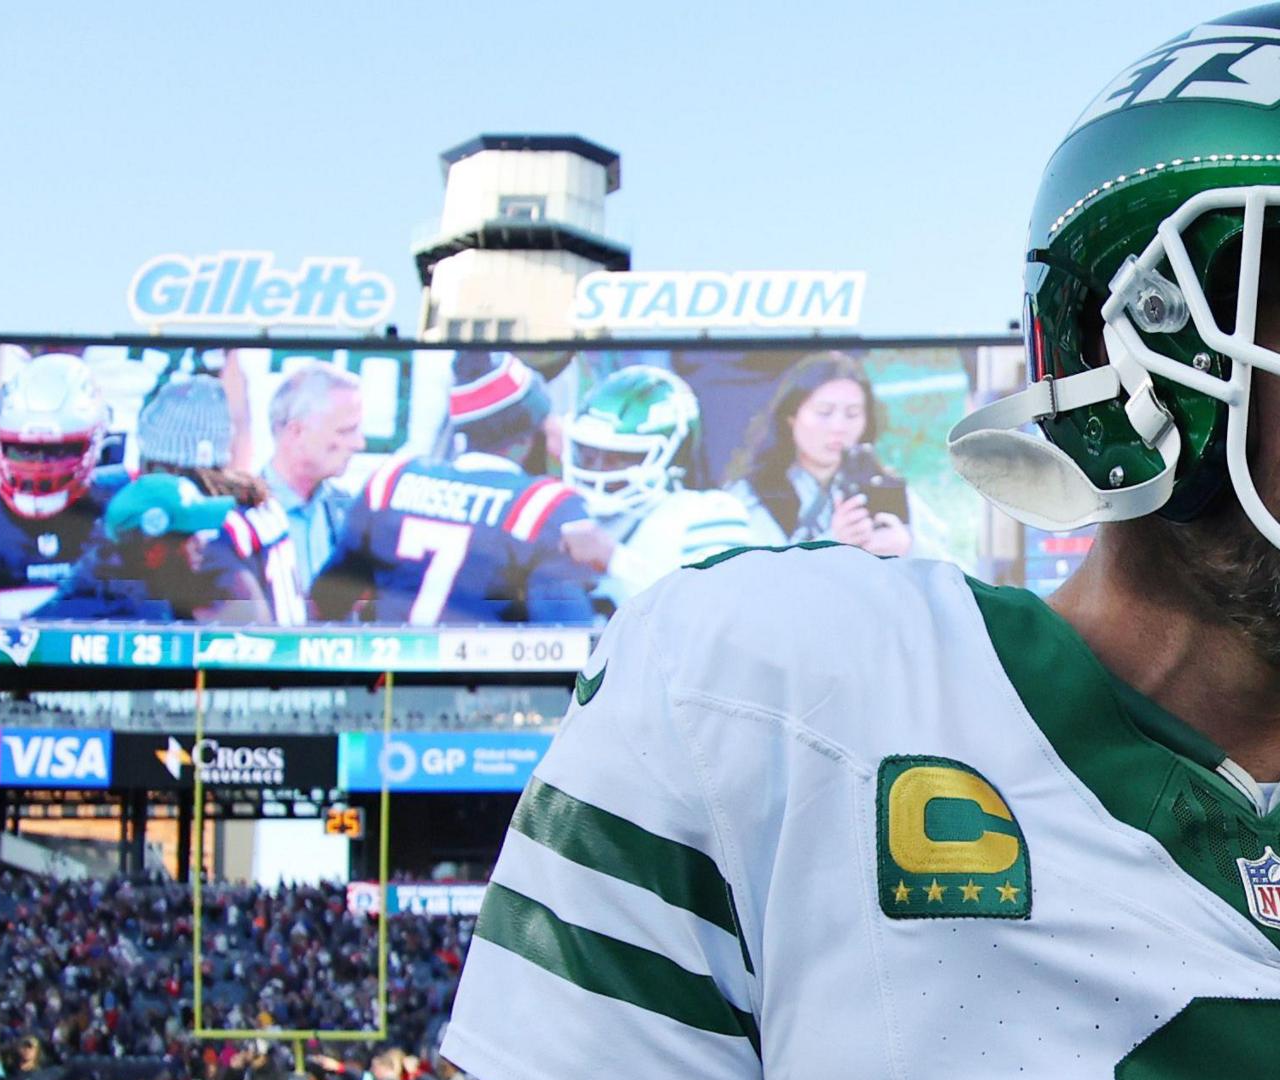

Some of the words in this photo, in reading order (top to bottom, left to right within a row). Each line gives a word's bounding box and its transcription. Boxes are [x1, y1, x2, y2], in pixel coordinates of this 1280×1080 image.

[132, 257, 389, 320] Gillette
[575, 279, 856, 320] STADIUM
[397, 515, 472, 625] 7
[71, 634, 109, 664] NE
[132, 634, 162, 665] 25
[455, 641, 467, 660] 4
[512, 641, 563, 661] 0:00
[3, 736, 107, 779] VISA
[192, 738, 284, 770] CROSS
[422, 748, 465, 776] GP
[326, 809, 361, 836] 25
[889, 766, 1019, 874] C
